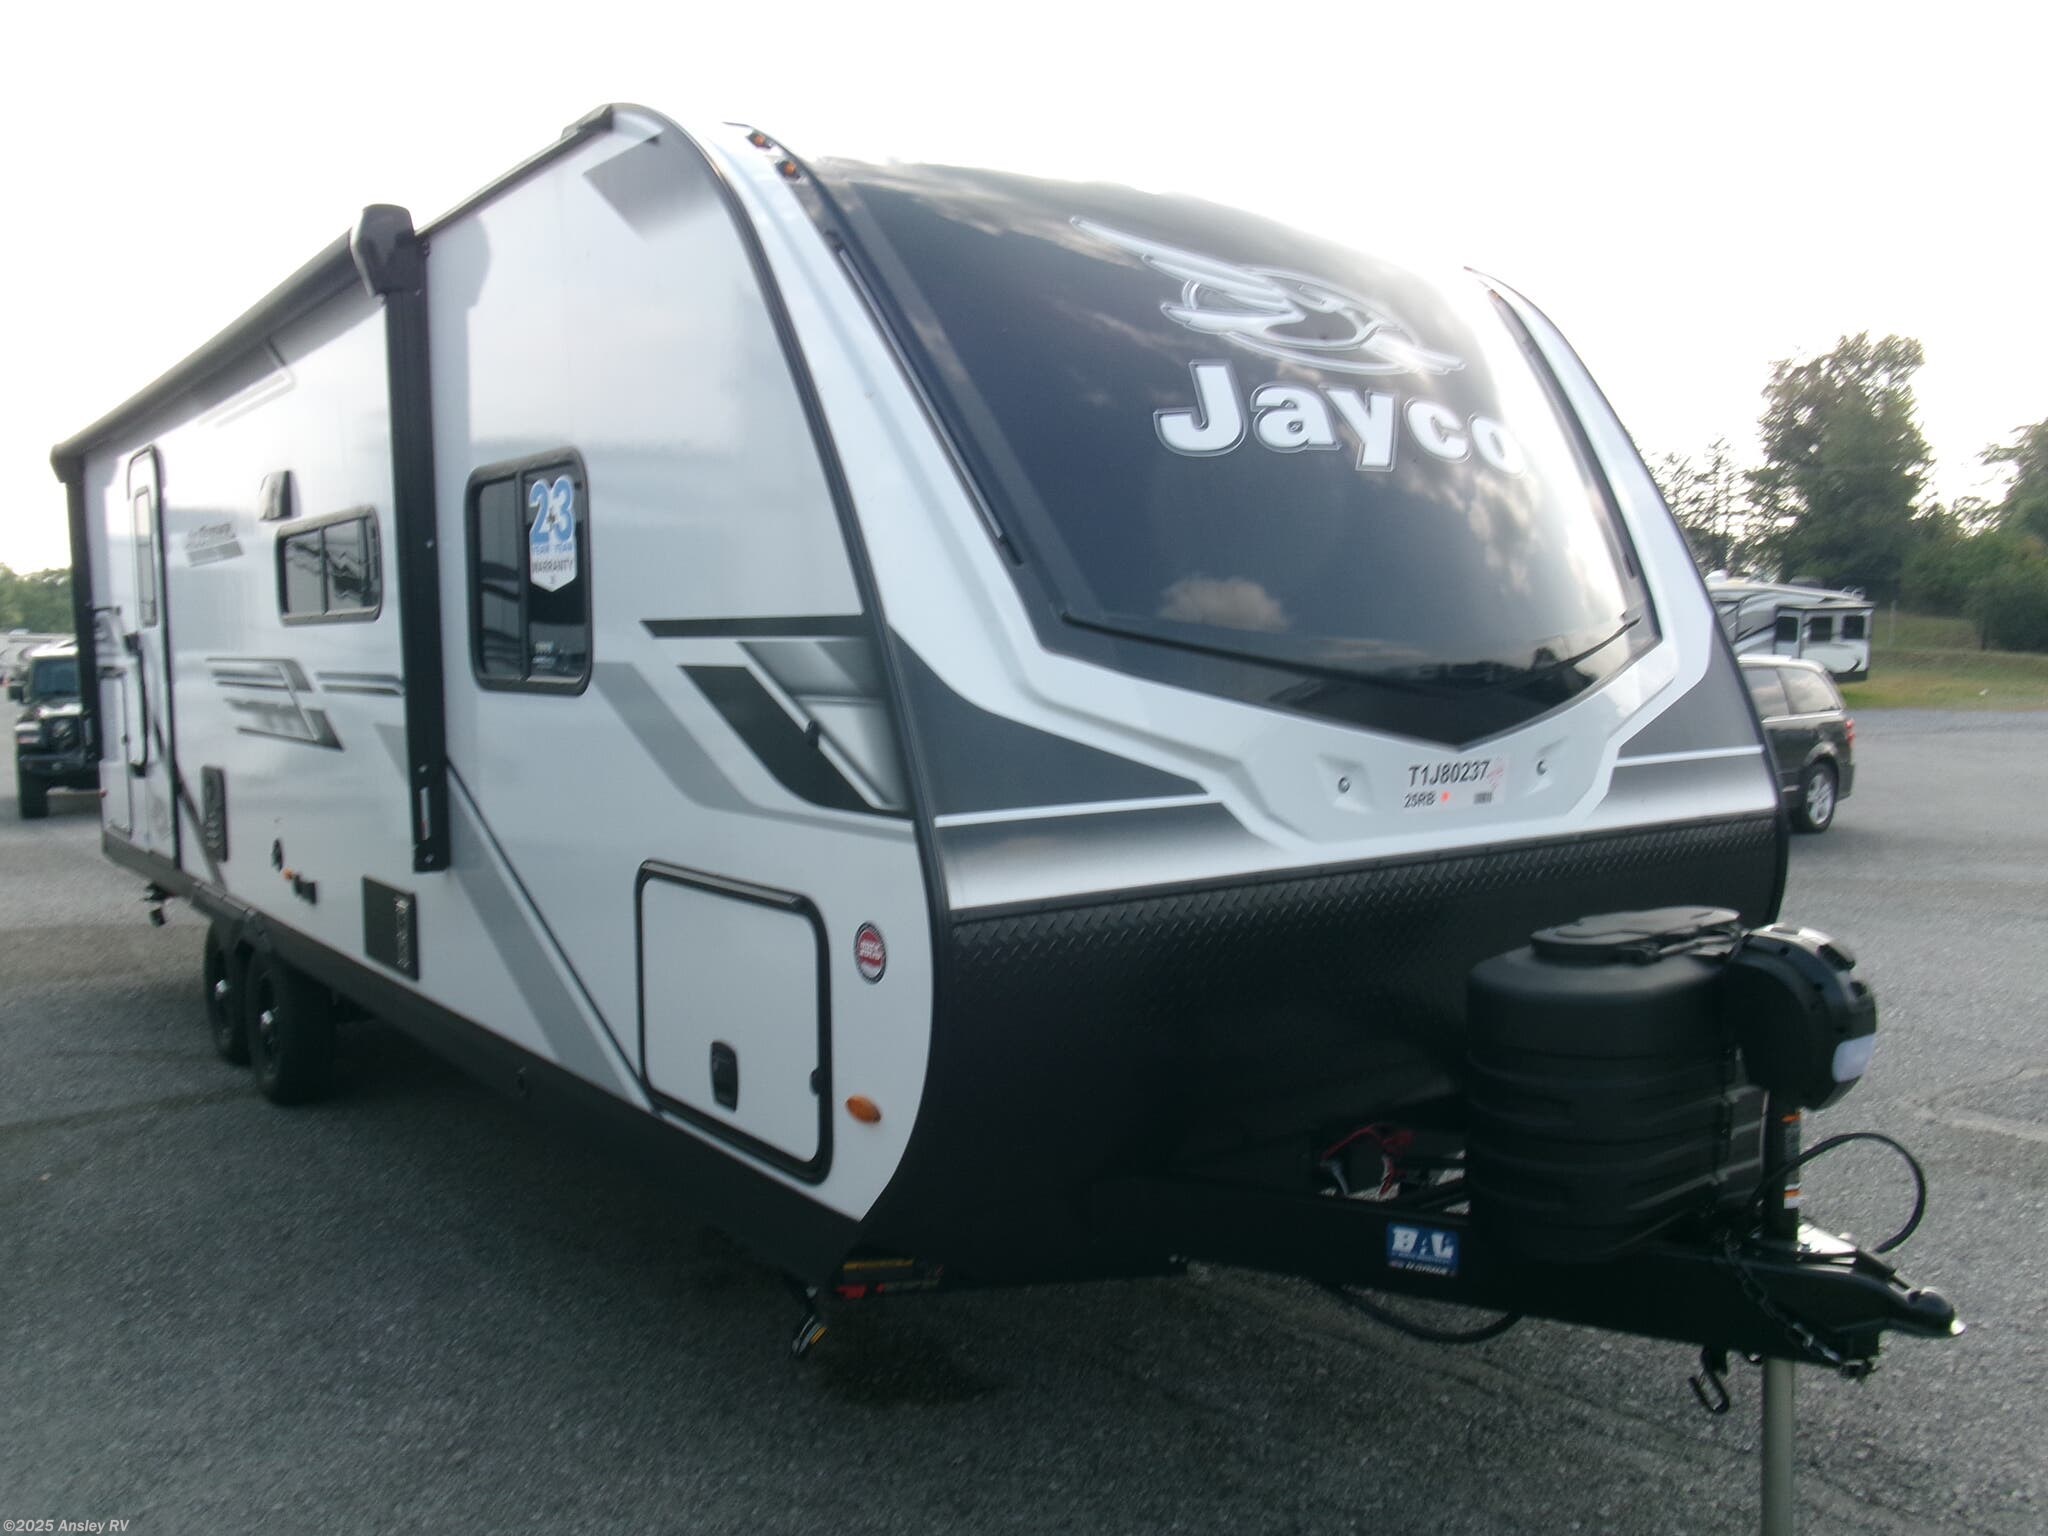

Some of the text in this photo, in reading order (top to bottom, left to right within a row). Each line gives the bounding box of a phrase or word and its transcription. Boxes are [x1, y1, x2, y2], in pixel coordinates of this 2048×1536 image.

[1153, 360, 1526, 478] Jayco
[1408, 759, 1491, 787] T1J80237
[1403, 791, 1437, 808] 25RB
